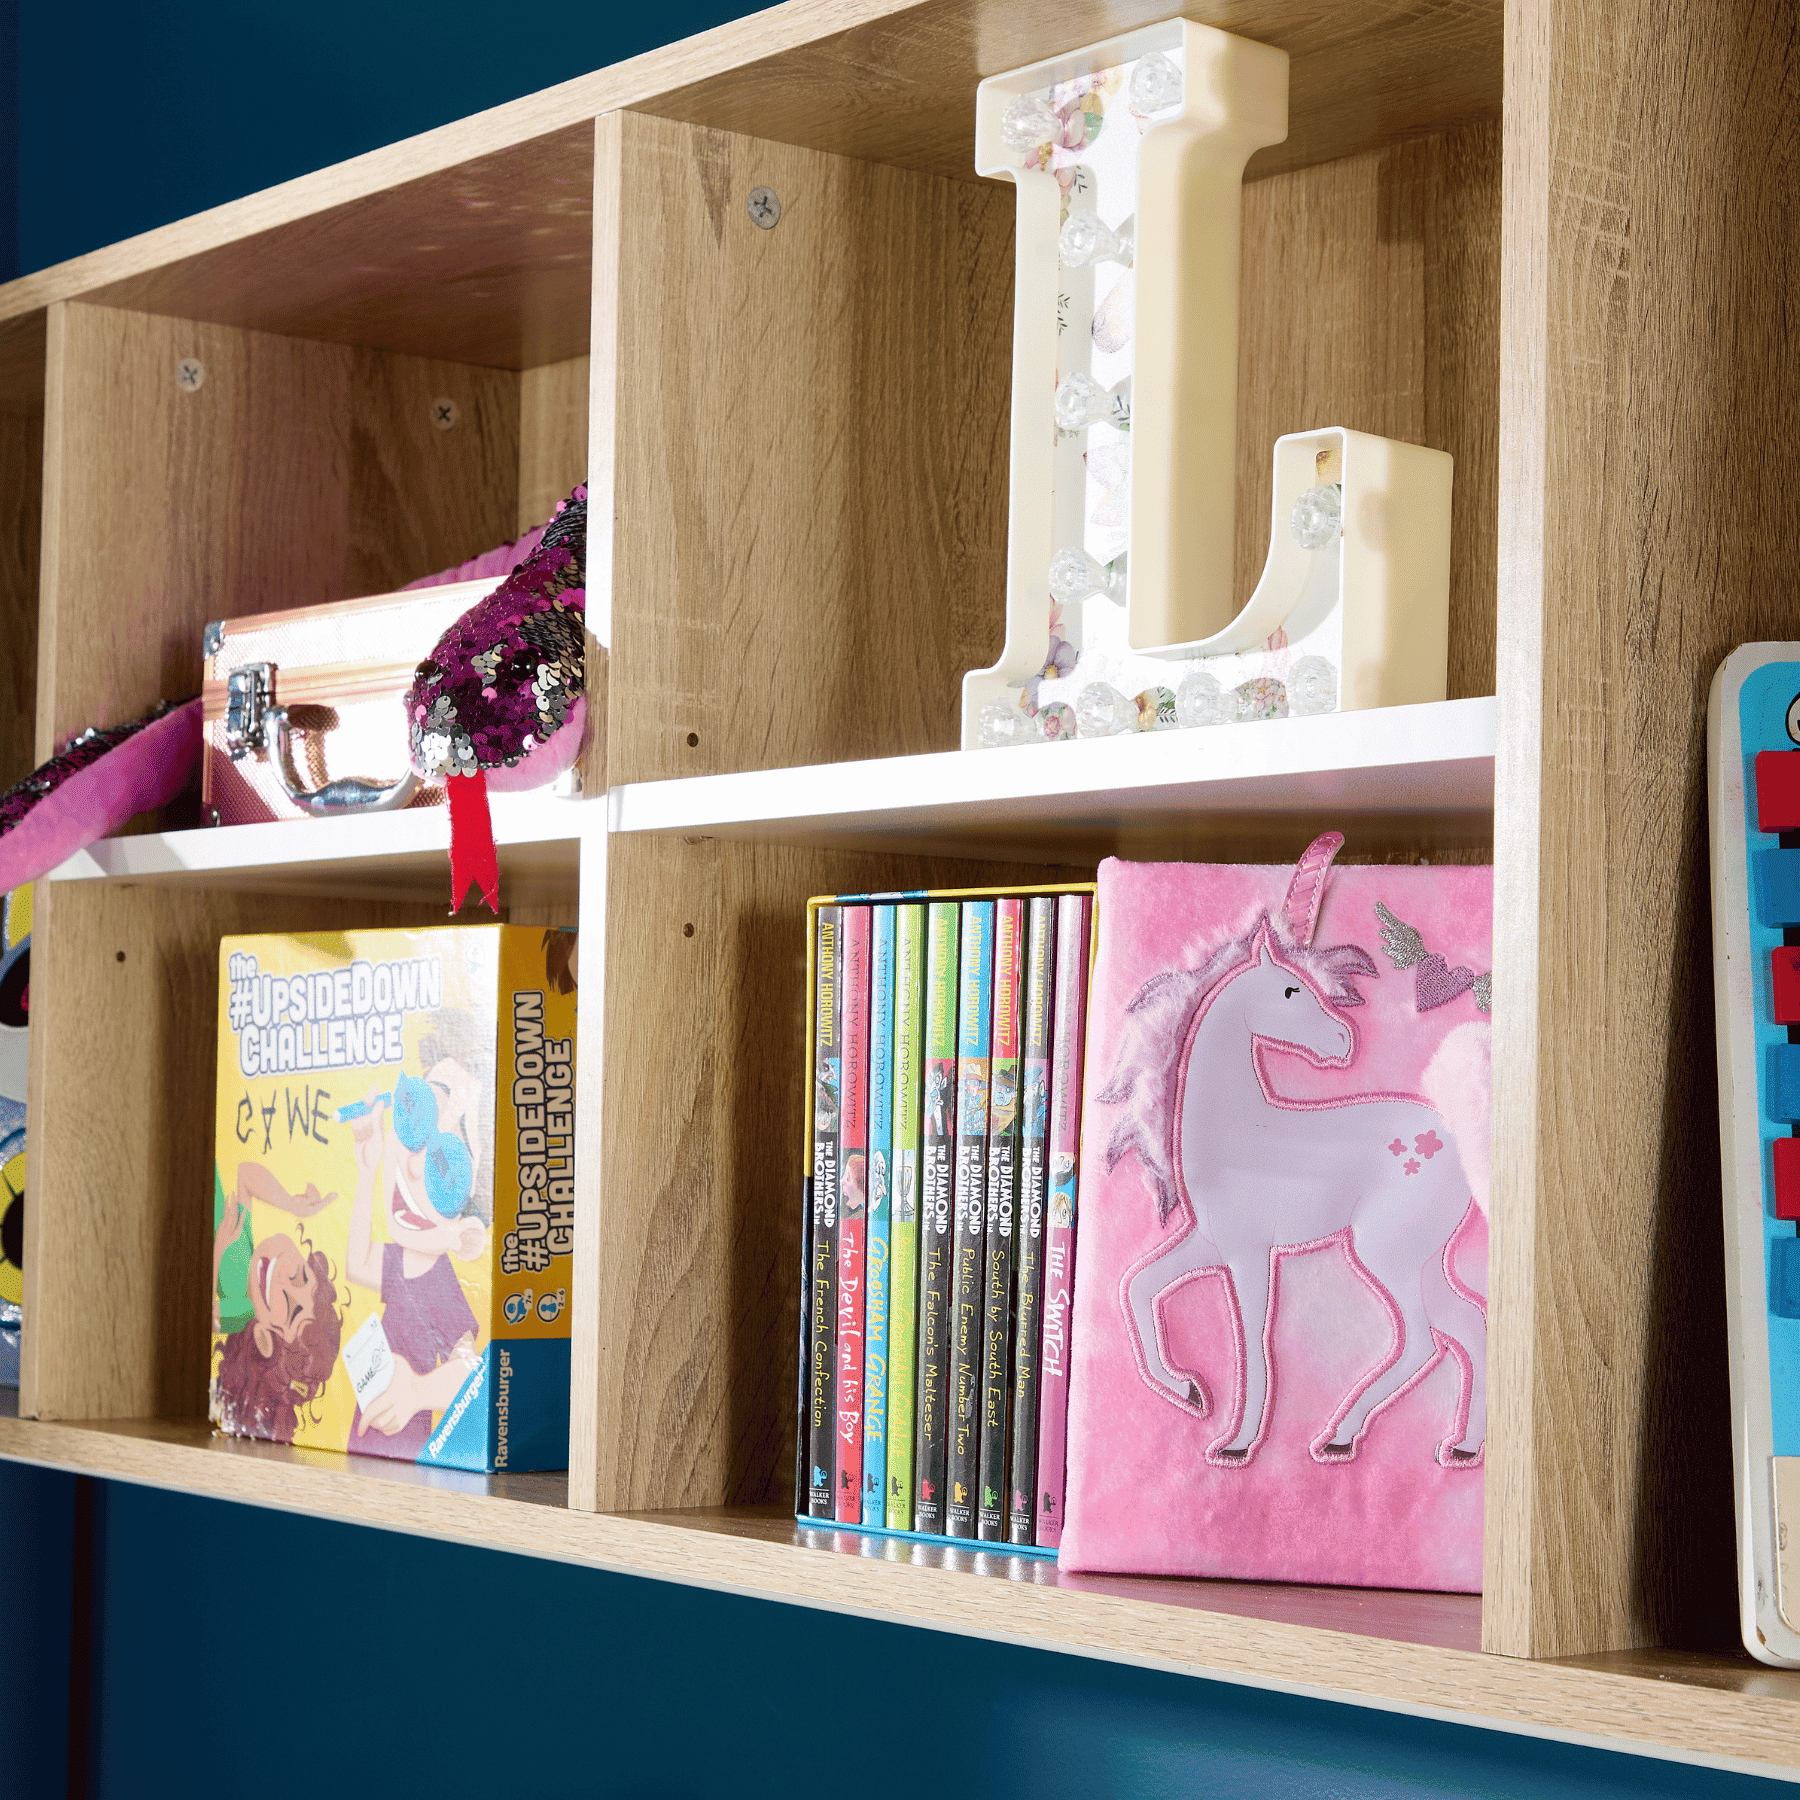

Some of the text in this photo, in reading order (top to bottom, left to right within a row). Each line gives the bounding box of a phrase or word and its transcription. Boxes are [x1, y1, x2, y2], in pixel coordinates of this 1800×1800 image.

[230, 953, 257, 980] the
[820, 922, 834, 1047] ANTHONY HOROWITZ
[932, 918, 947, 1046] ANTHONY HOROWITZ
[966, 916, 982, 1046] ANTHONY HOROWITZ
[997, 916, 1014, 1046] ANTHONY HOROWITZ
[1030, 916, 1046, 1046] ANTHONY HOROWITZ
[240, 1014, 403, 1077] CHALLENGE
[846, 938, 860, 1128] ANTHONY HOROWITZ
[874, 938, 887, 1129] ANTHONY HOROWITZ
[898, 938, 911, 1129] ANTHONY HOROWITZ
[545, 1038, 574, 1255] CHALLENGE
[814, 1143, 825, 1213] BROTHERS
[823, 1141, 836, 1228] THE DIAMOND
[923, 1145, 936, 1220] BROTHERS
[935, 1145, 949, 1234] THE DIAMOND
[956, 1145, 969, 1220] BROTHERS
[969, 1145, 982, 1235] THE DIAMOND
[987, 1147, 1000, 1222] BROTHERS
[999, 1146, 1013, 1237] THE DIAMOND
[1020, 1147, 1032, 1224] BROTHERS
[1030, 1146, 1042, 1238] THE DIAMOND
[501, 1232, 520, 1273] the
[814, 1240, 830, 1428] The French Confection
[839, 1232, 860, 1445] The Devil and his Boy
[924, 1247, 942, 1441] The Falcon's Malteser
[957, 1248, 975, 1455] Public Enemy Number Two
[987, 1250, 1005, 1427] South by South East
[1018, 1252, 1035, 1398] The Blurred Man
[428, 1364, 487, 1459] Ravensburger
[495, 1349, 513, 1468] Ravensburger
